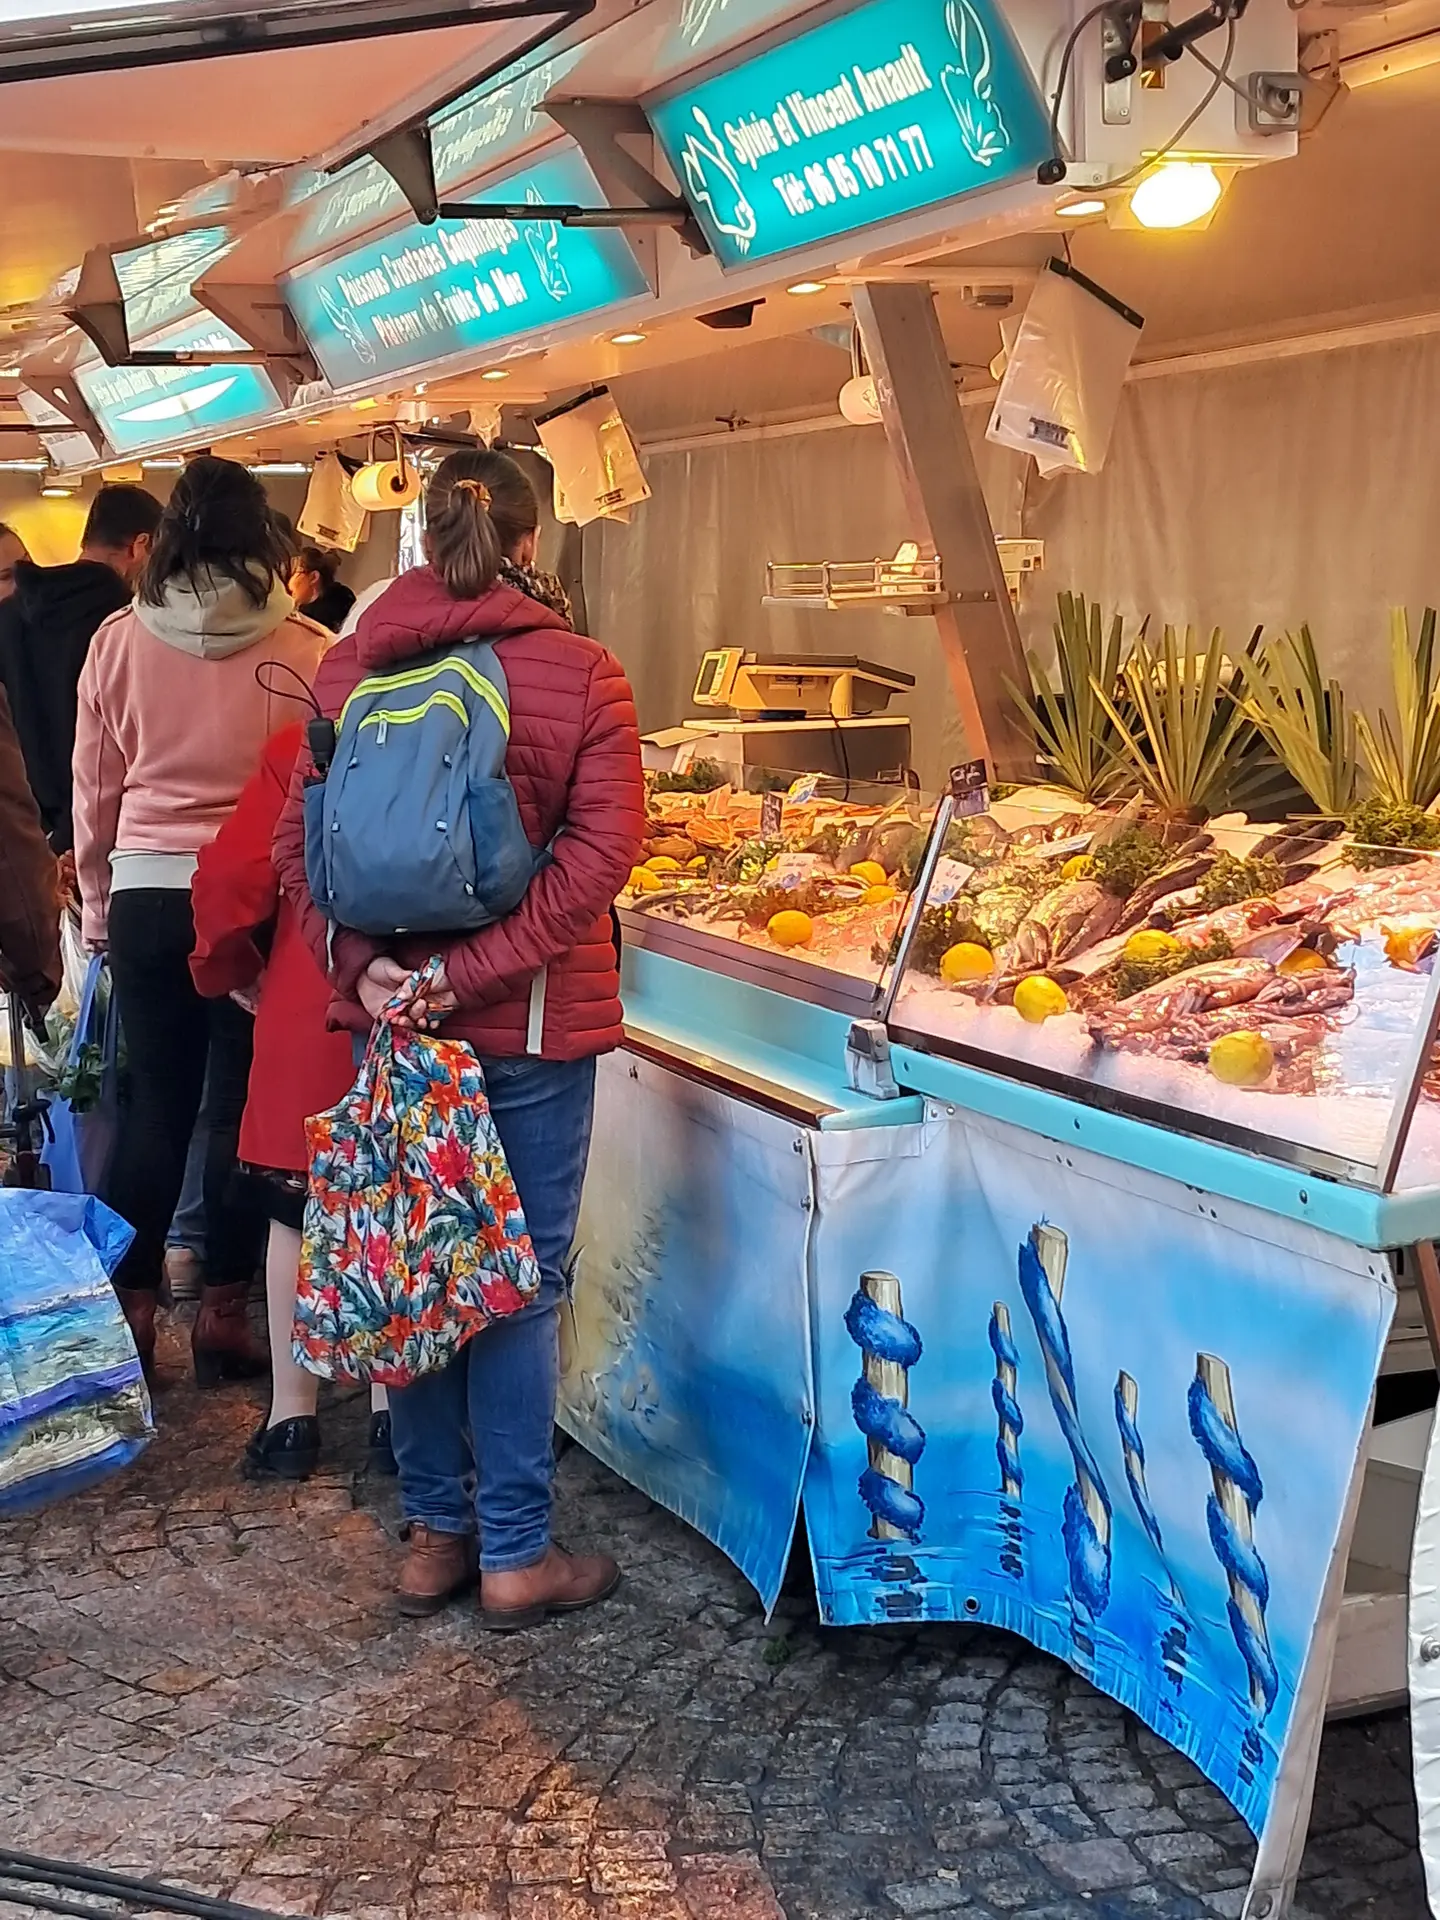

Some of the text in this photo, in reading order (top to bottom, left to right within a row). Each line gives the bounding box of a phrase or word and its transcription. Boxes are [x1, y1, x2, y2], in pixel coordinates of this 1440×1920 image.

[724, 43, 933, 171] Sylvie et Vincent Arnault
[803, 162, 837, 206] 06
[852, 144, 884, 189] 10
[873, 134, 909, 182] 71
[898, 124, 935, 172] 77
[336, 267, 391, 309] Poissons
[381, 237, 447, 289] Crustacés
[371, 267, 528, 349] Plateaux de Fruits de Mer
